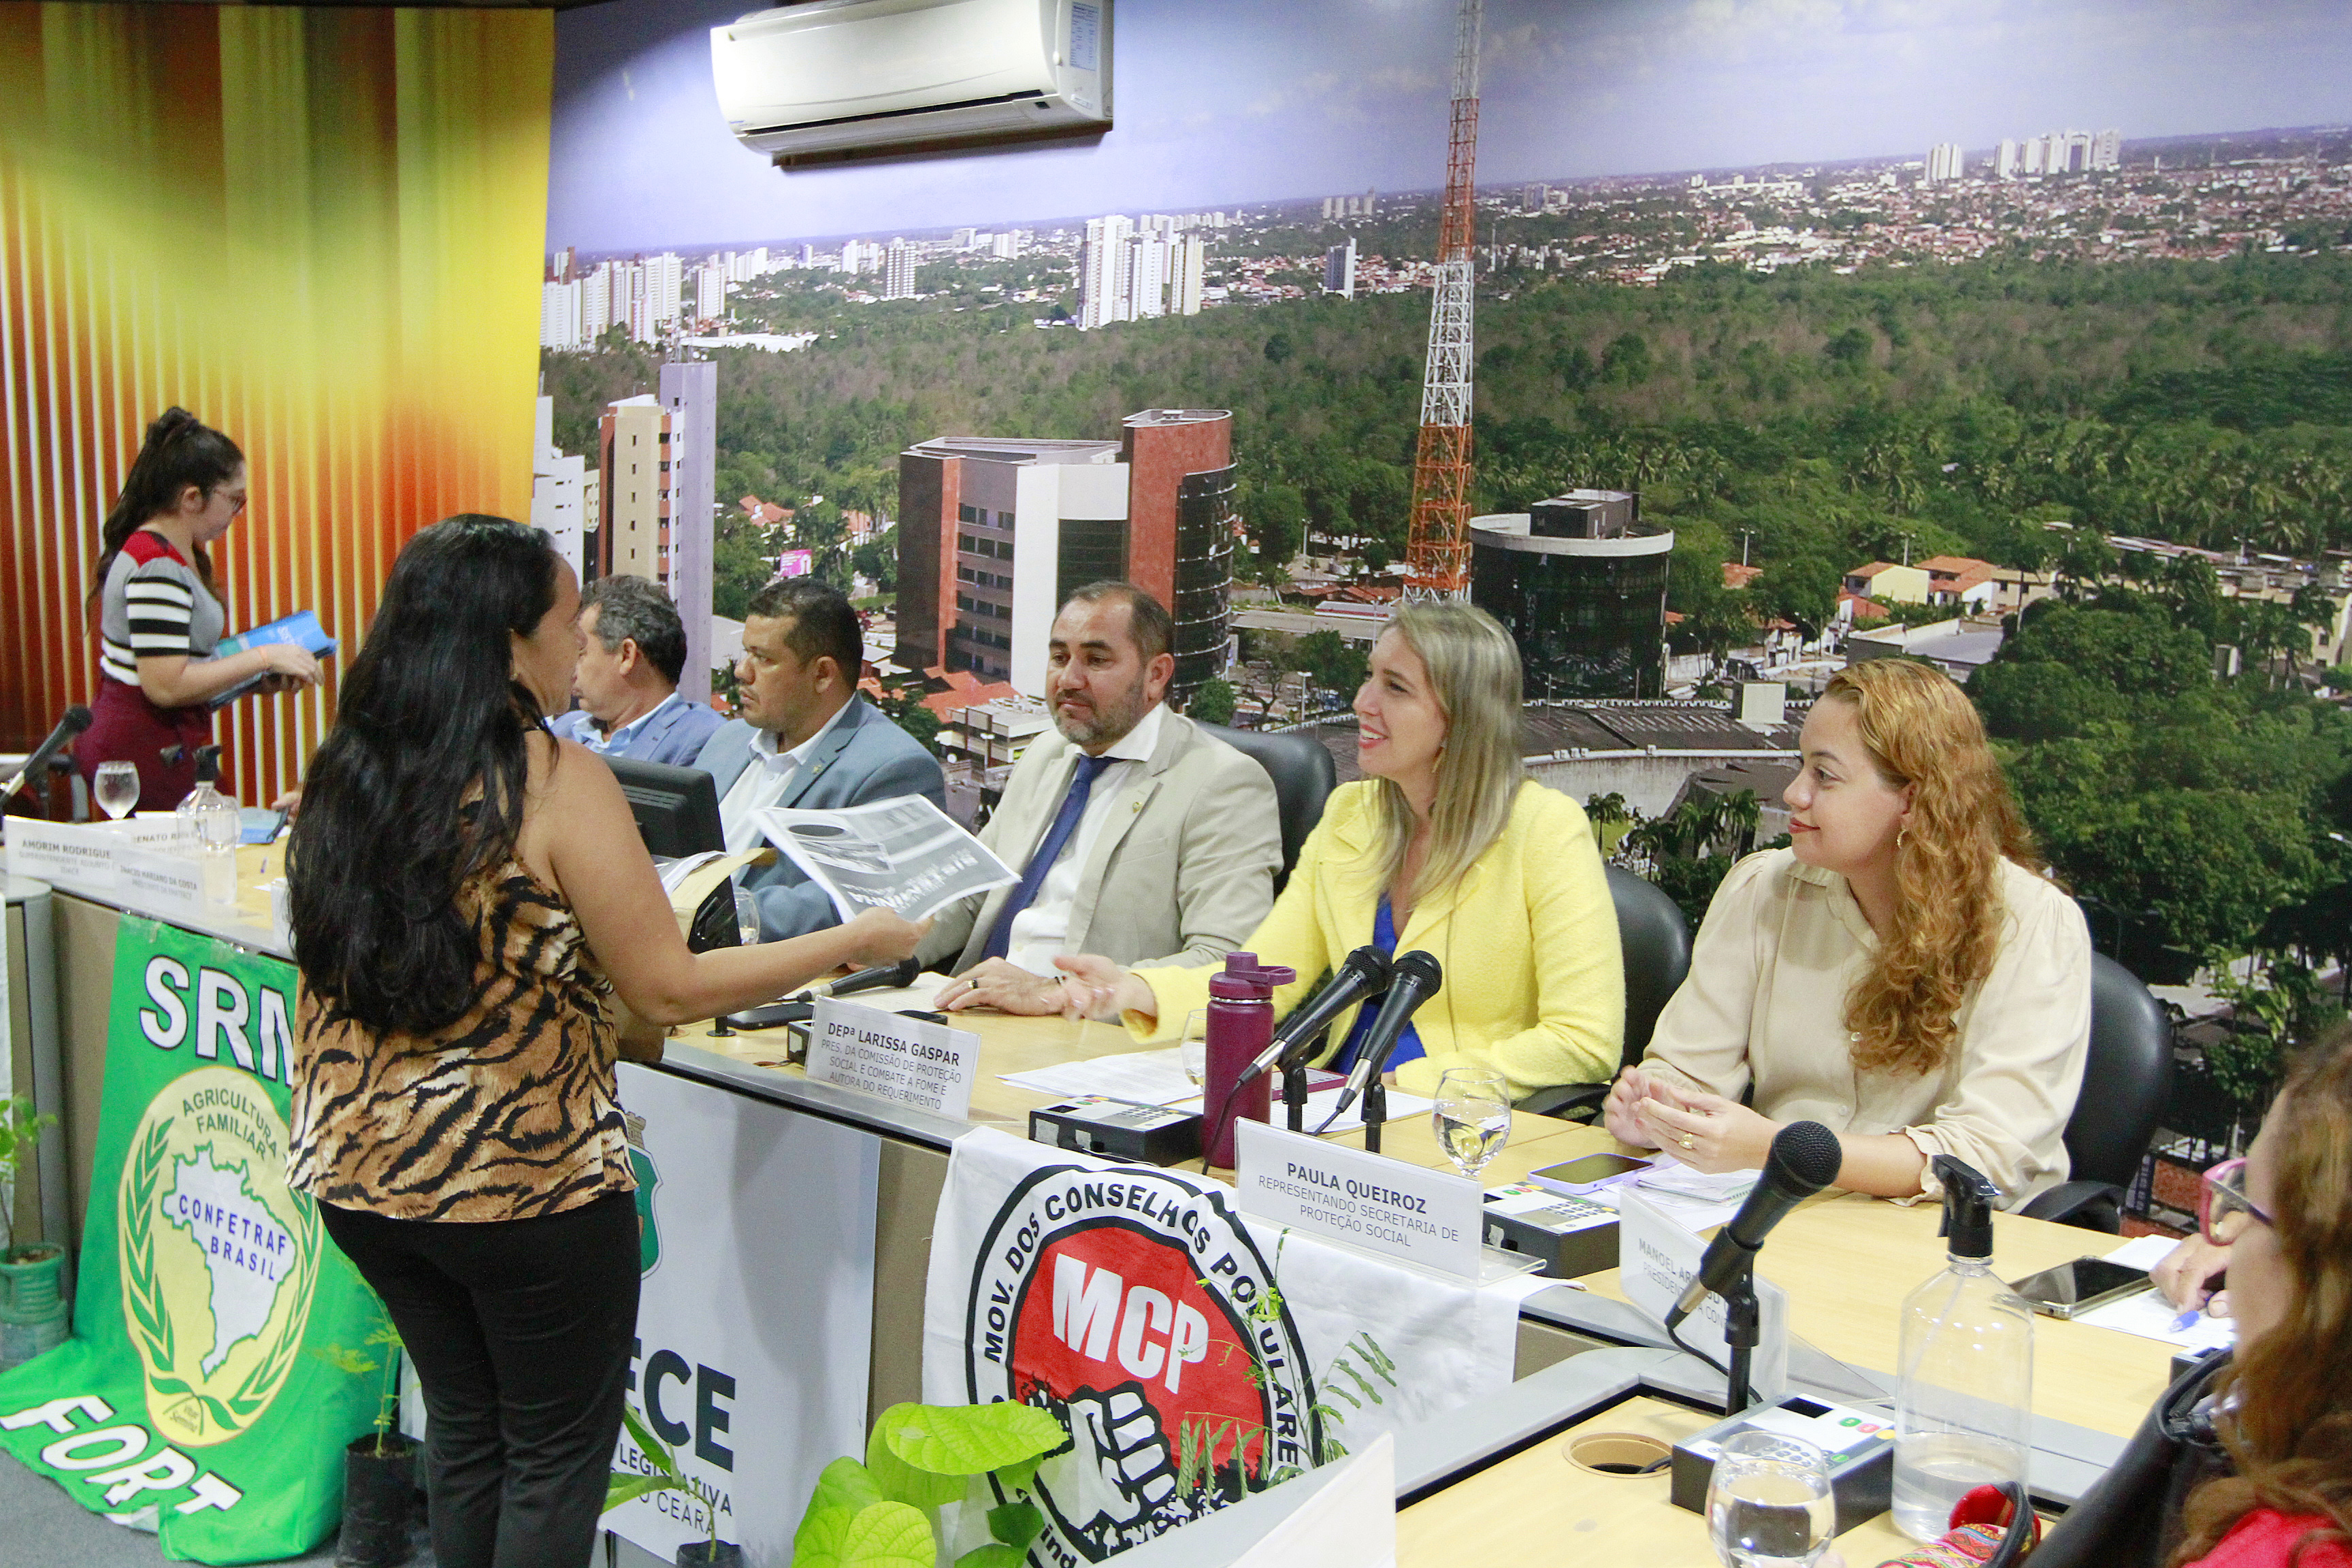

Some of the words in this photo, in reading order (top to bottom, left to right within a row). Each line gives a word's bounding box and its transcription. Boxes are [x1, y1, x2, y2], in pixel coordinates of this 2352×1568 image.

[22, 839, 60, 852] AMORIM
[821, 1039, 842, 1054] PRES.
[845, 1045, 855, 1056] DA
[858, 1049, 900, 1068] COMISSÃO
[903, 1060, 915, 1071] DE
[917, 1063, 961, 1083] PROTEÇÃO
[858, 1030, 906, 1054] LARISSA
[911, 1043, 959, 1066] GASPAR
[829, 1072, 860, 1088] AUTORA
[864, 1080, 875, 1092] DO
[878, 1084, 941, 1110] REQUERIMENTO
[830, 1056, 858, 1074] SOCIAL
[860, 1064, 865, 1075] E
[868, 1066, 905, 1085] COMBATE
[906, 1076, 913, 1087] A
[916, 1078, 938, 1093] FOME
[941, 1085, 947, 1096] E
[182, 1088, 278, 1158] AGRICULTURA
[197, 1115, 266, 1162] FAMILIAR
[1258, 1175, 1356, 1213] REPRESENTANDO
[1360, 1205, 1437, 1237] SECRETARIA
[1442, 1226, 1459, 1242] DE
[1287, 1162, 1341, 1191] PAULA
[1346, 1179, 1426, 1215] QUEIROZ
[179, 1194, 287, 1257] CONFETRAF
[1301, 1204, 1361, 1232] PROTEÇÃO
[1366, 1223, 1411, 1247] SOCIAL
[210, 1236, 276, 1282] BRASIL
[984, 1278, 1015, 1363] MOV.
[1004, 1211, 1041, 1276] DOS
[1045, 1181, 1211, 1255] CONSELHOS
[1639, 1237, 1677, 1276] MANOEL
[1052, 1252, 1209, 1395] MCP
